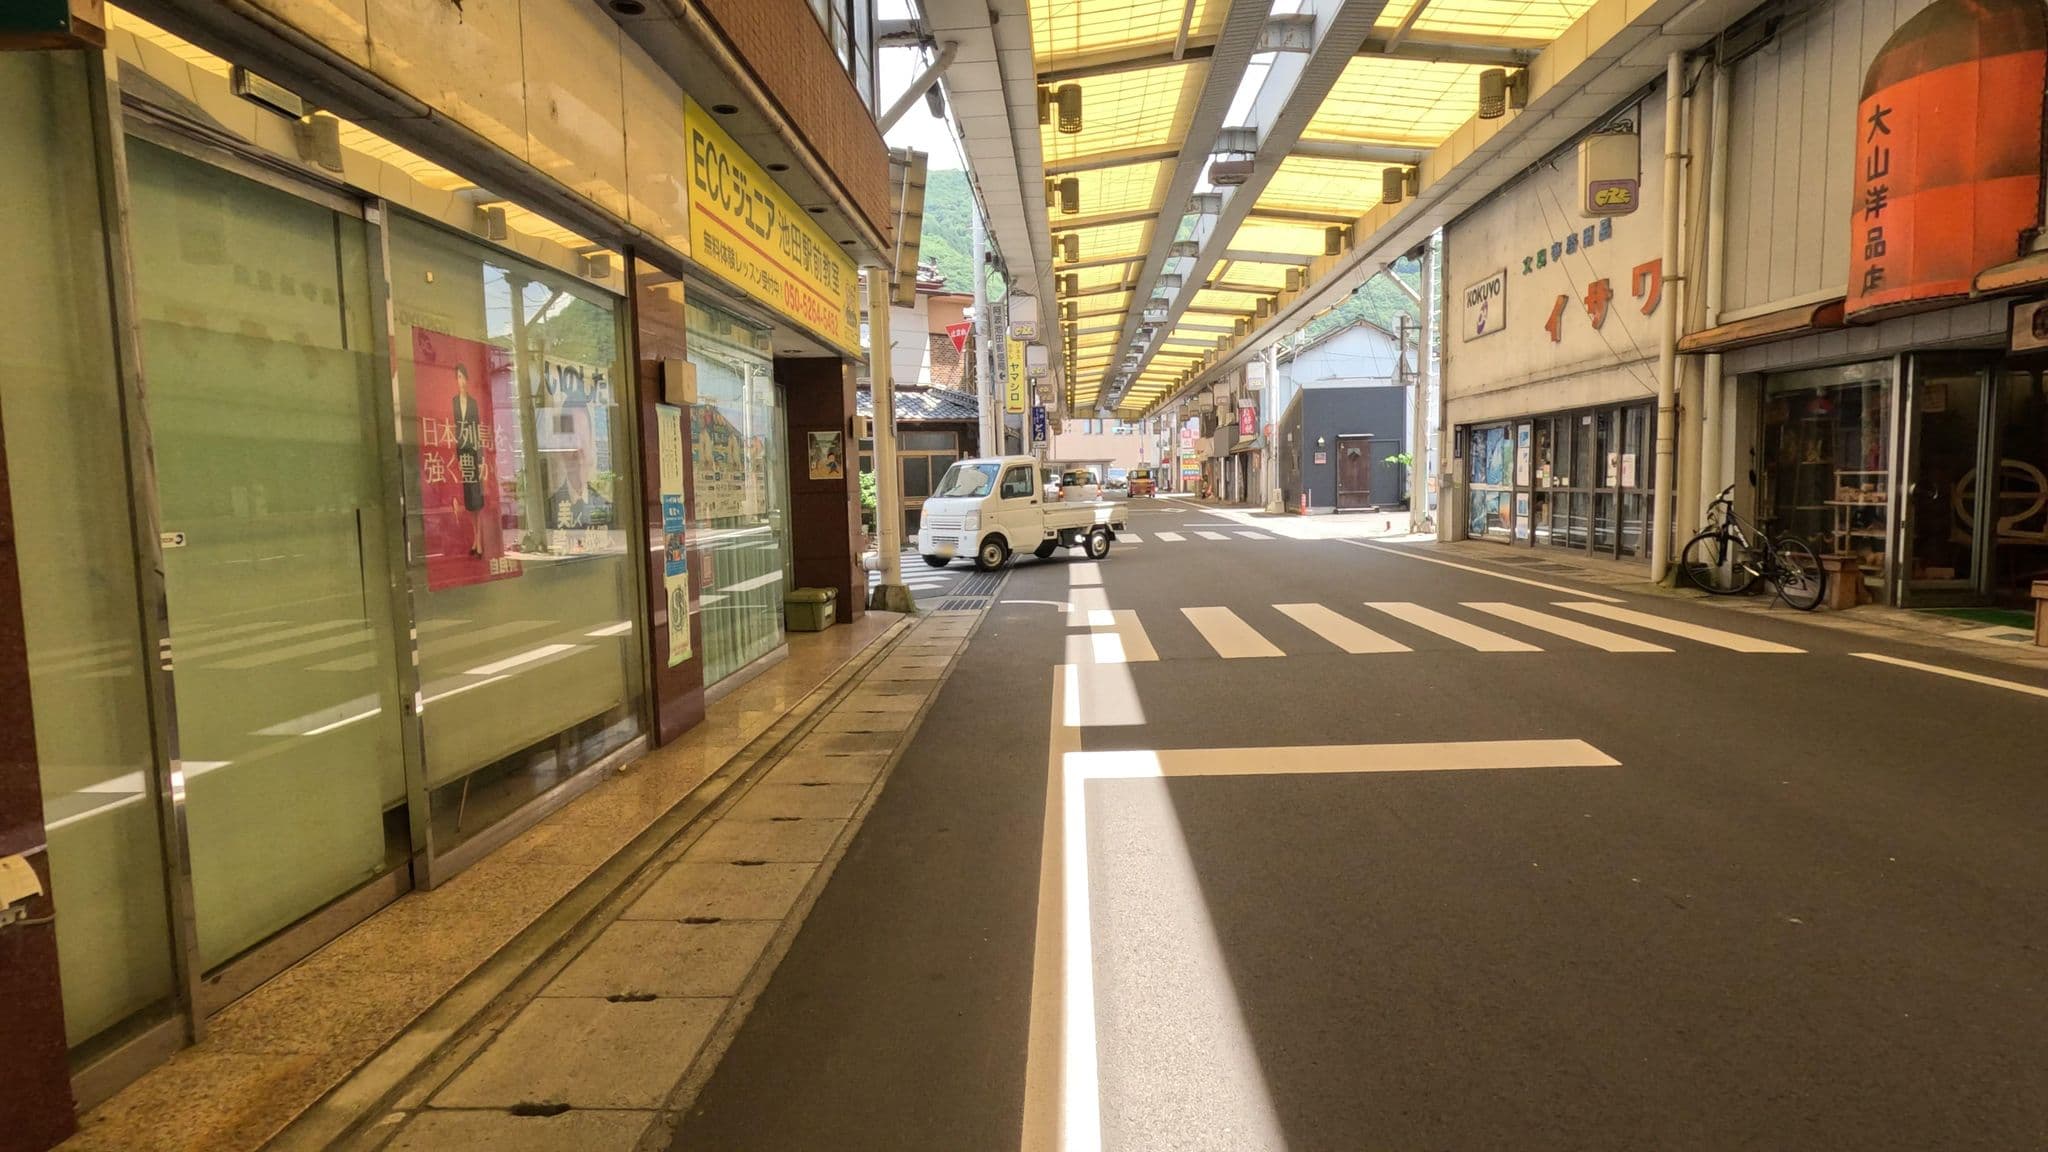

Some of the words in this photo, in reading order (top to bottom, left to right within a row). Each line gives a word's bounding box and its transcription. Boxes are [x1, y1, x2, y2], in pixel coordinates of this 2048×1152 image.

[1860, 104, 1893, 298] 大山洋品店
[777, 208, 841, 296] 池田駅前教室
[1466, 278, 1502, 309] KOKUYO
[1544, 258, 1663, 344] イサワ
[1008, 362, 1021, 402] ヤマシロ
